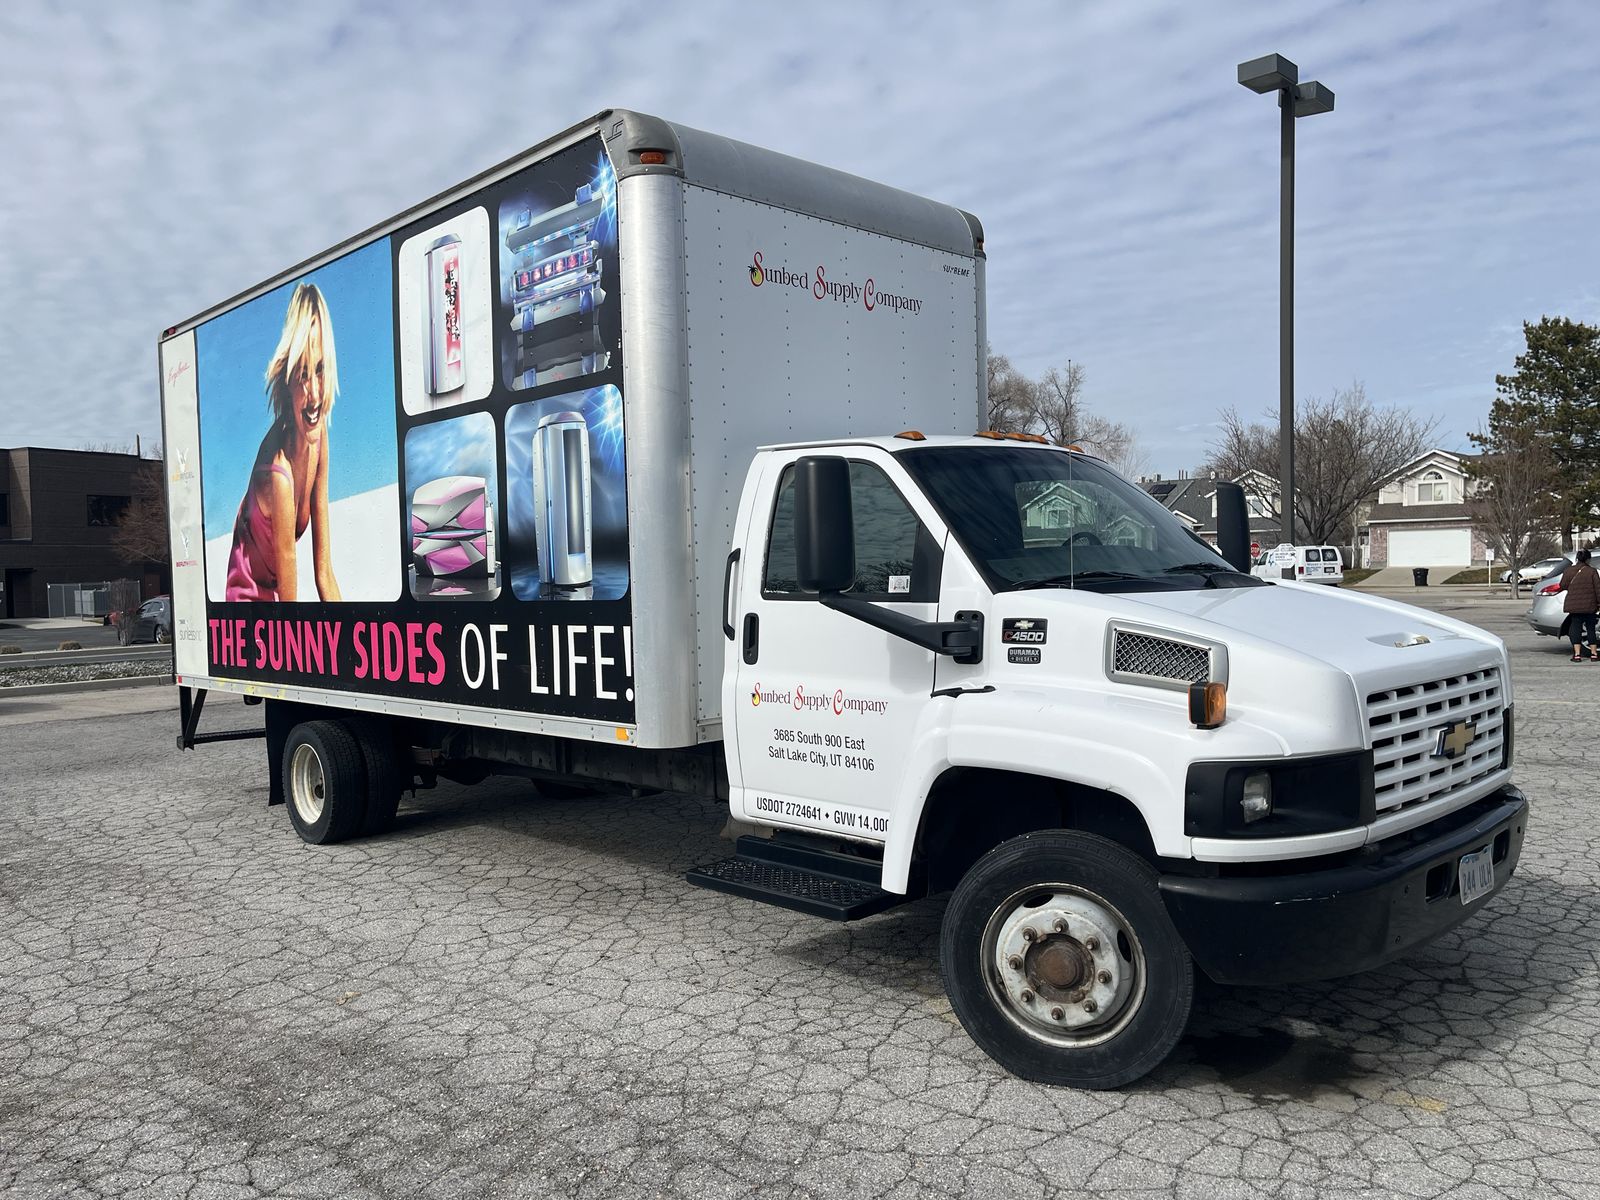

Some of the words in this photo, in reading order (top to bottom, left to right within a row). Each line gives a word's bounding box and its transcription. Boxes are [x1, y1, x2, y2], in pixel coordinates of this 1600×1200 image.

[750, 251, 809, 290] Sunbed
[813, 265, 862, 303] Supply
[864, 278, 923, 315] Company
[1004, 631, 1044, 641] C4500
[209, 619, 248, 668] THE
[255, 620, 342, 676] SUNNY
[353, 621, 446, 686] SIDES
[460, 622, 509, 691] OF
[528, 624, 634, 702] LIFE!
[751, 682, 791, 707] Sunbed
[793, 685, 832, 711] Supply
[833, 689, 889, 715] Company
[773, 728, 795, 743] 3685
[797, 731, 823, 746] South
[824, 734, 842, 748] 900
[844, 736, 866, 751] East
[768, 745, 785, 760] Salt
[787, 748, 808, 763] Lake
[809, 751, 829, 767] City,
[830, 754, 842, 767] UT
[845, 756, 875, 771] 84106
[756, 796, 785, 814] USDOT
[785, 801, 822, 821] 2724641
[834, 810, 856, 827] GVW
